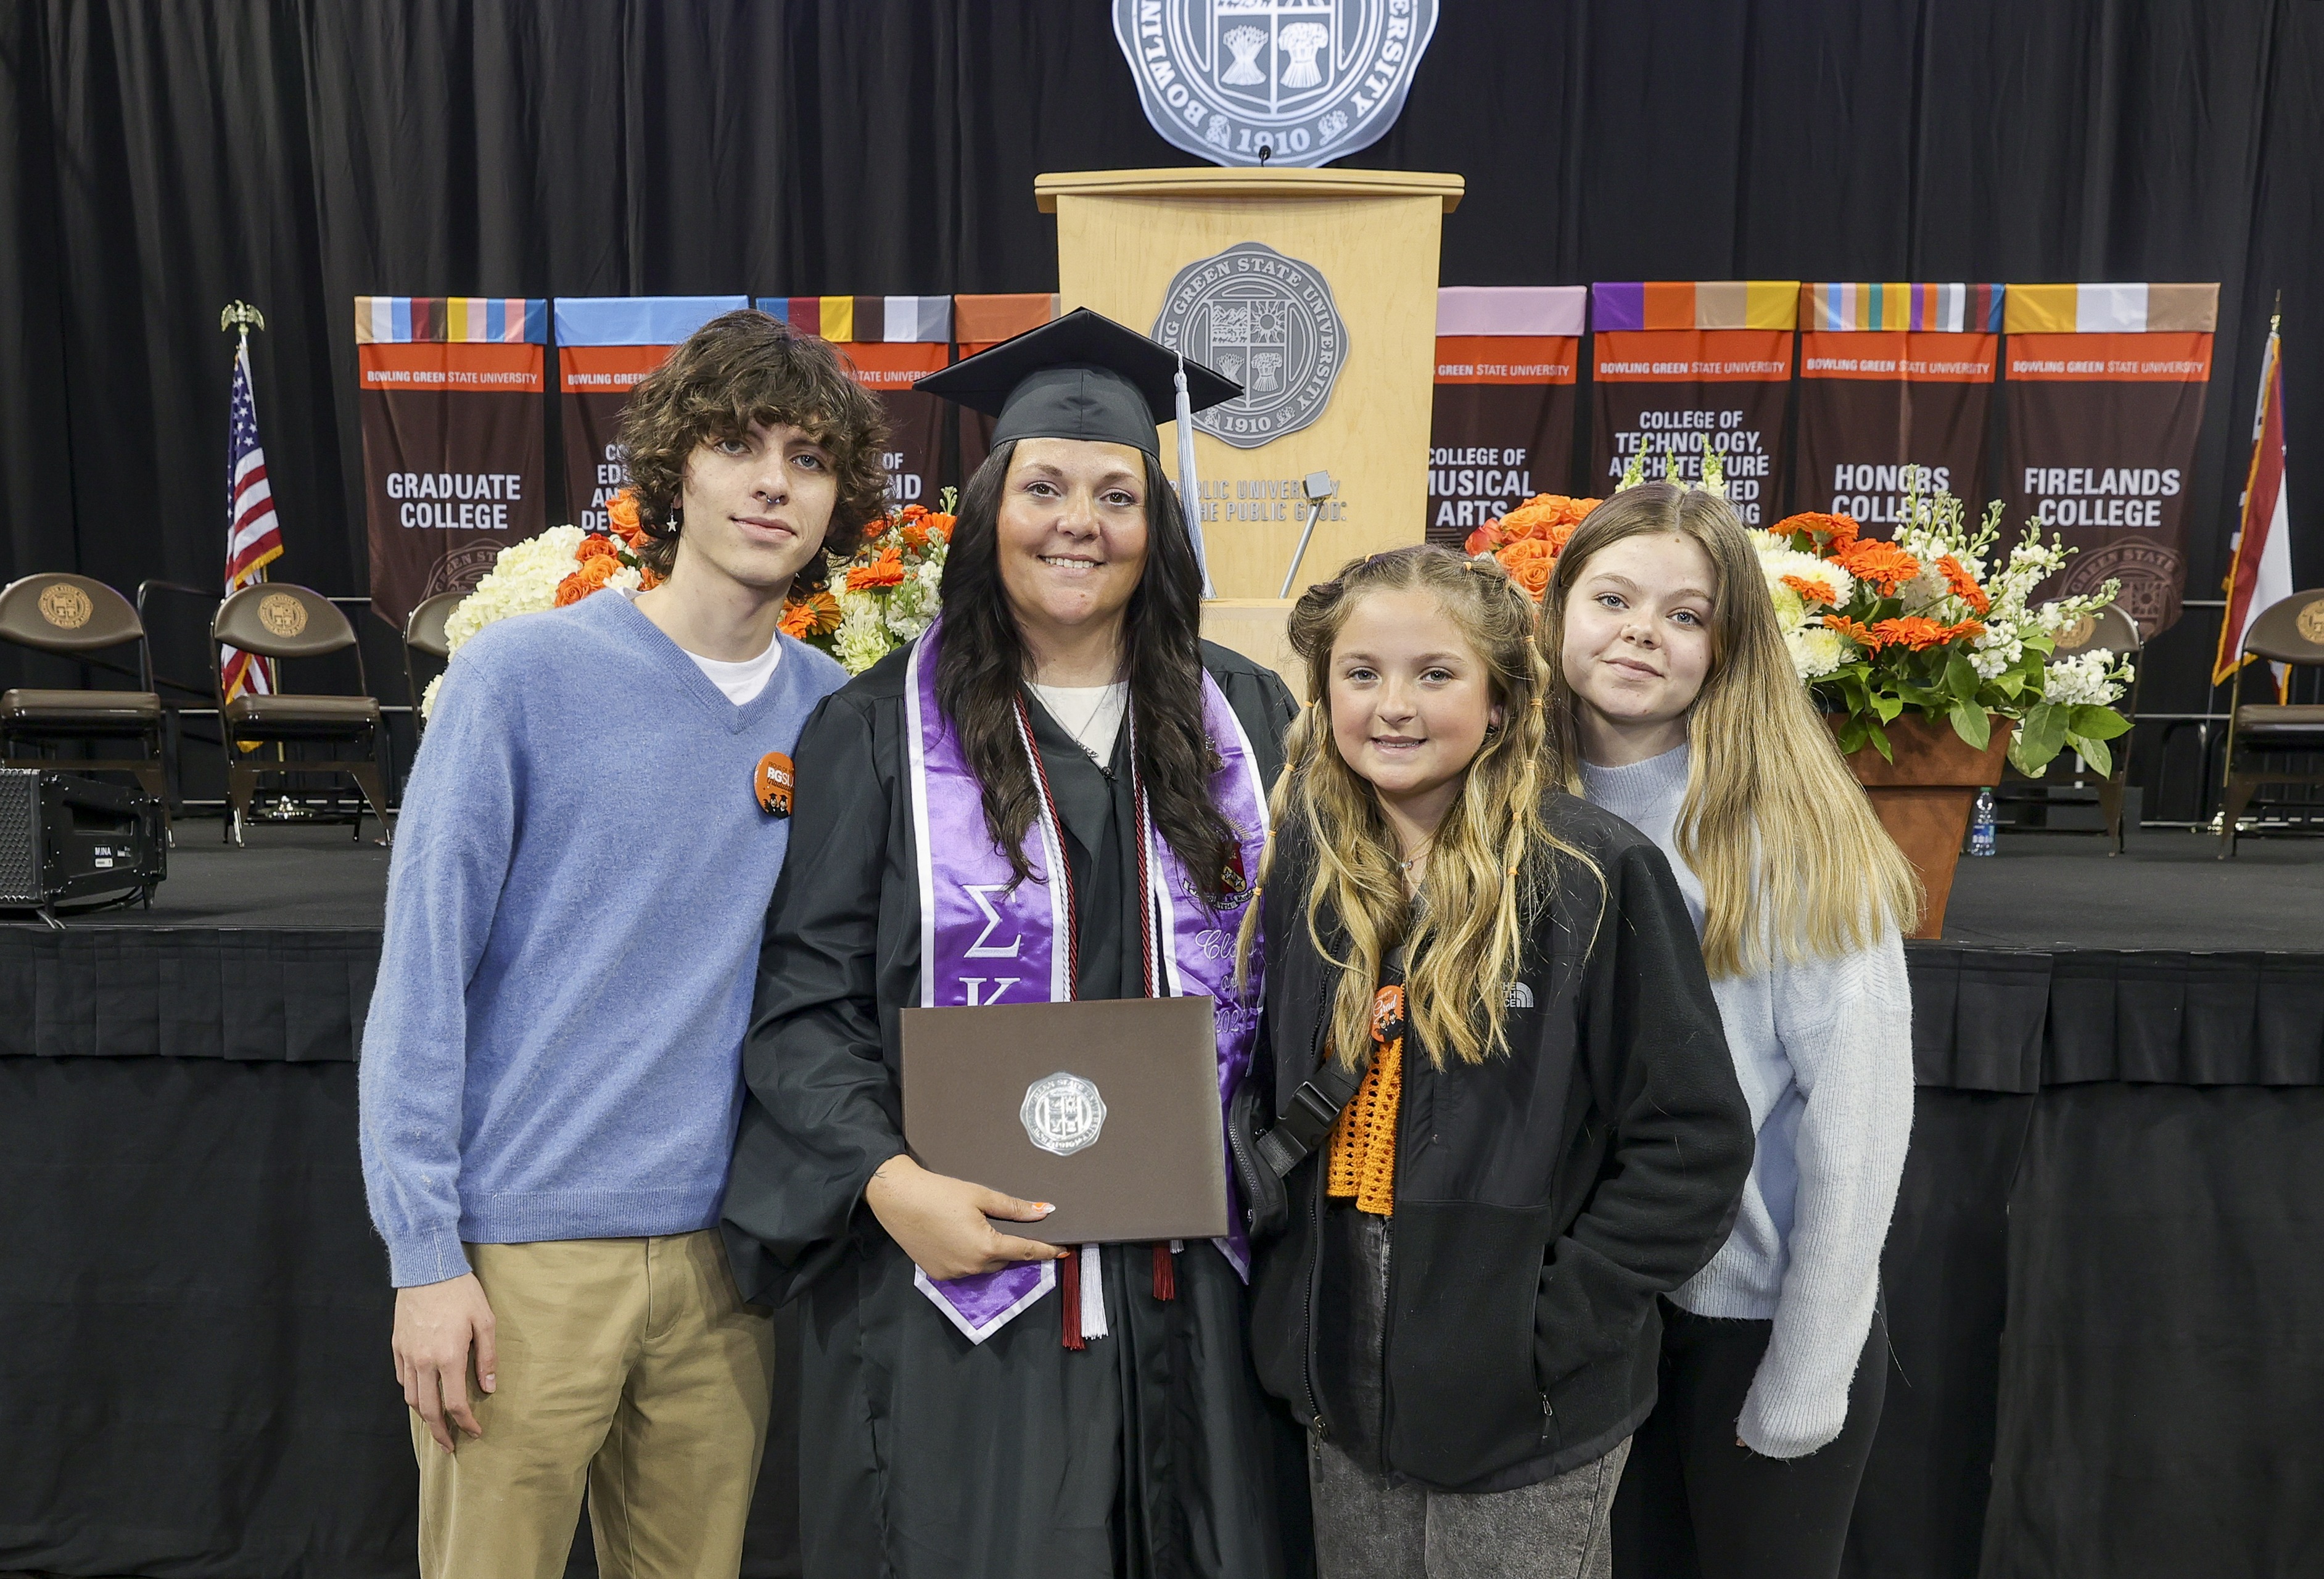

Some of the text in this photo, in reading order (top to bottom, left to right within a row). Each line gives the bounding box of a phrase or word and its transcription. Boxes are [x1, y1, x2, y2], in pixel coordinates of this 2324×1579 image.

[1236, 128, 1311, 155] 1910
[1174, 258, 1334, 411] GREEN STATE UNIVERSITY
[1438, 364, 1570, 377] GREEN STATE UNIVERSITY
[1600, 361, 1786, 374] BOWLING GREEN STATE UNIVERSITY
[1807, 358, 1990, 374] BOWLING GREEN STATE UNIVERSITY
[2013, 361, 2204, 373] BOWLING GREEN STATE UNIVERSITY
[367, 371, 537, 384] BOWLING GREEN STATE UNIVERSITY
[568, 373, 611, 385] BOWLING
[1224, 416, 1272, 432] 1910
[1639, 410, 1743, 429] COLLEGE OF
[882, 452, 904, 469] OF
[1428, 448, 1527, 466] COLLEGE OF
[386, 472, 521, 501] GRADUATE
[1237, 479, 1340, 500] UNIVERY
[2024, 467, 2181, 497] FIRELANDS
[400, 503, 508, 530] COLLEGE
[1199, 502, 1219, 522] HE
[1226, 502, 1287, 521] PUBLIC
[1435, 500, 1509, 527] ARTS
[2038, 498, 2162, 527] COLLEGE
[767, 766, 794, 788] BGSU
[1373, 994, 1397, 1018] Grad
